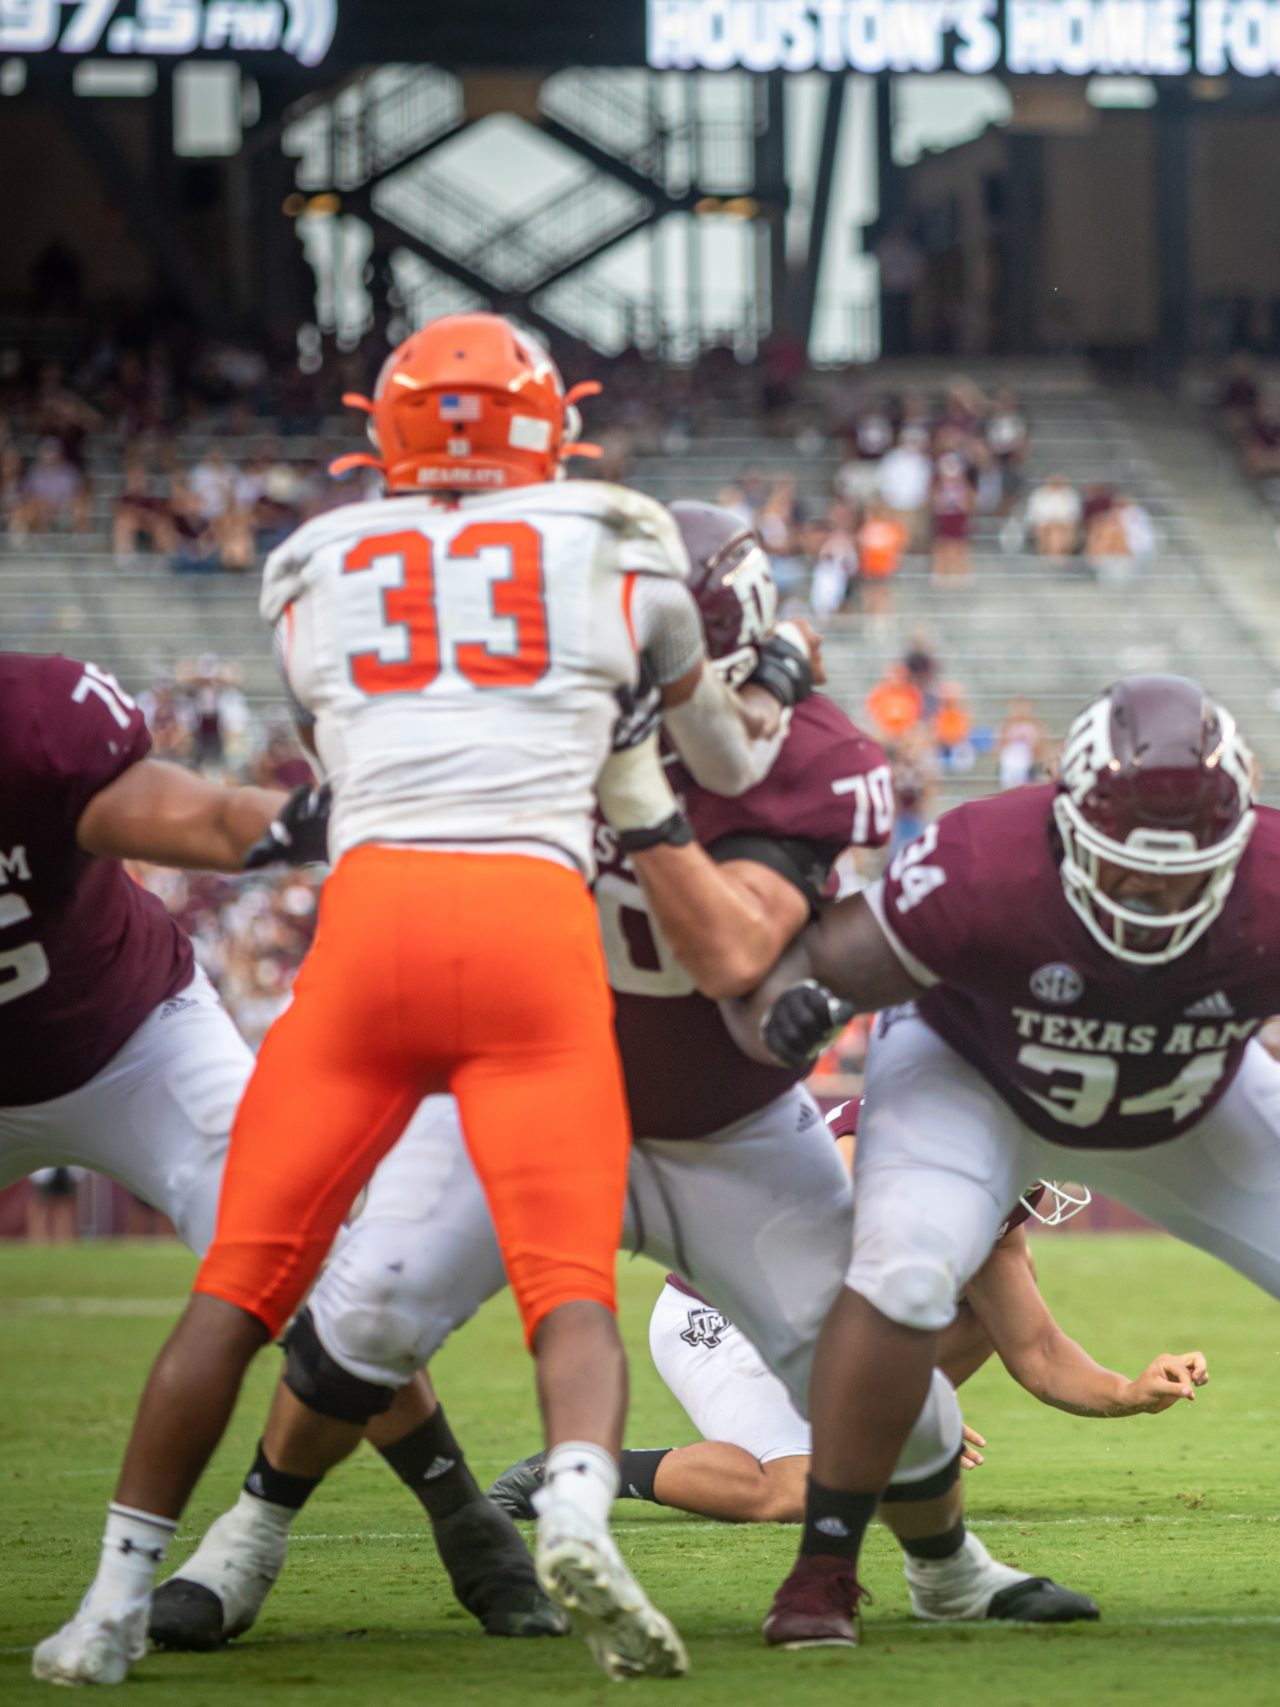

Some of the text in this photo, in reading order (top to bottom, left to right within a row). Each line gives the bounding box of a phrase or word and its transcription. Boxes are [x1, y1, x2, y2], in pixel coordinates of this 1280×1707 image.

[645, 0, 1000, 73] HOUSTON'S
[1004, 0, 1191, 75] HOME
[341, 518, 551, 695] 33
[831, 765, 894, 843] 70
[890, 823, 946, 914] 34
[1011, 1006, 1260, 1055] TEXAS A&M
[1016, 1042, 1227, 1129] 34
